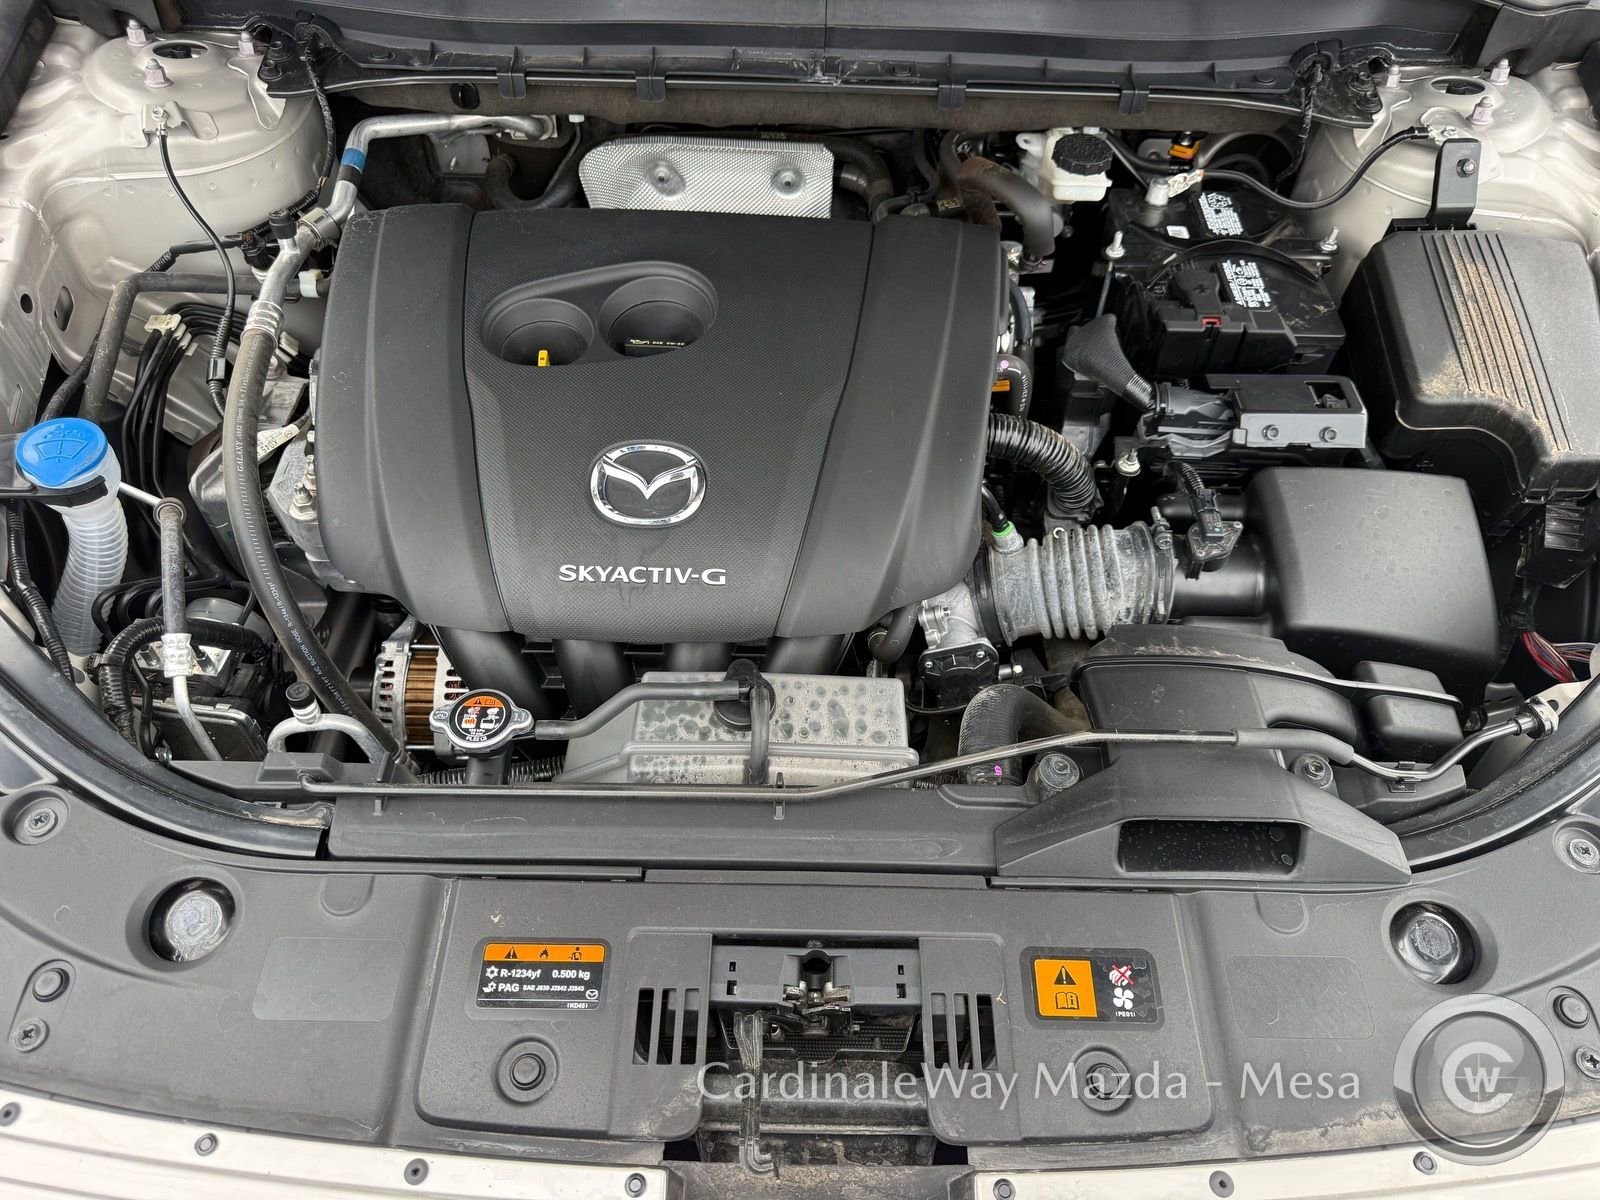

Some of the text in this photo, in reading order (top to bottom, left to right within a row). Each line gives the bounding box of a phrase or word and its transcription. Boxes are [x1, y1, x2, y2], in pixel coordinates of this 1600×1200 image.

[235, 440, 244, 472] GALAXY
[558, 564, 727, 585] SKYACTIV-G
[290, 628, 302, 643] HOSE
[300, 644, 318, 668] SUCTION
[499, 969, 591, 980] R-1234yf 0.500 kg
[498, 983, 520, 992] PAG
